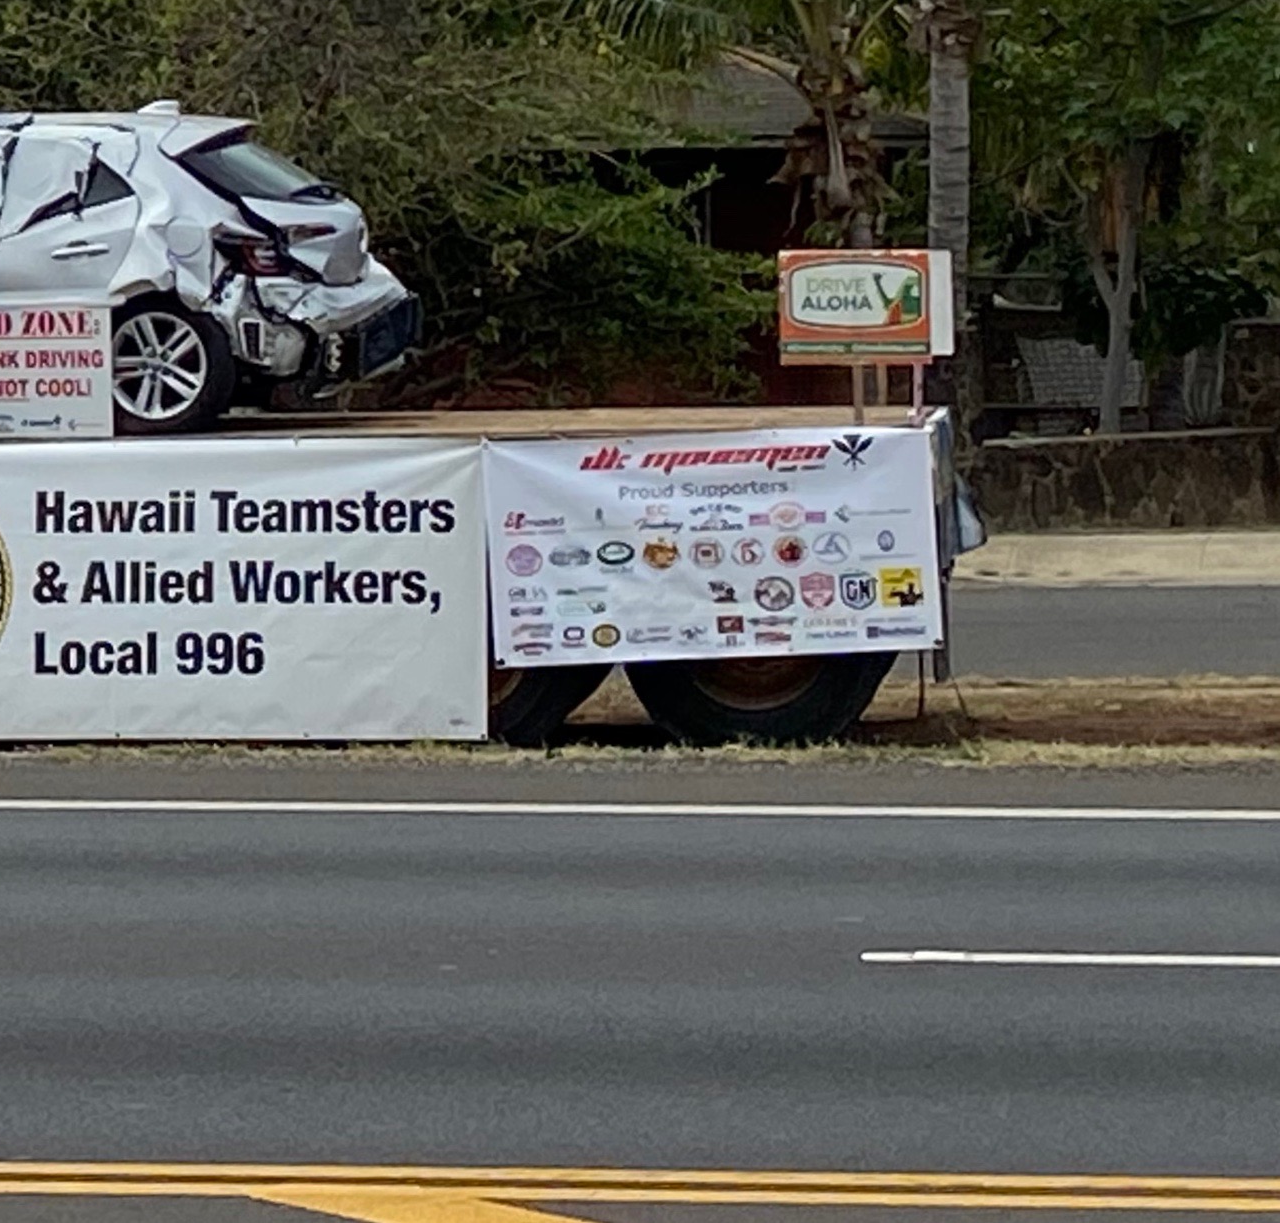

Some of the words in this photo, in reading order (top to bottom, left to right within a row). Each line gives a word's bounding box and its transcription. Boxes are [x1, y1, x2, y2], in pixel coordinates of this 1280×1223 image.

[806, 277, 866, 293] DRIVE
[801, 295, 873, 311] ALOHA
[25, 349, 104, 368] DRIVING
[618, 484, 674, 501] Proud
[681, 479, 789, 500] Supporters
[34, 489, 196, 534] Hawaii
[209, 489, 455, 535] Teamsters
[32, 560, 67, 605] &
[81, 559, 214, 605] Allied
[227, 559, 442, 614] Workers,
[34, 631, 157, 677] Local
[175, 632, 265, 677] 996
